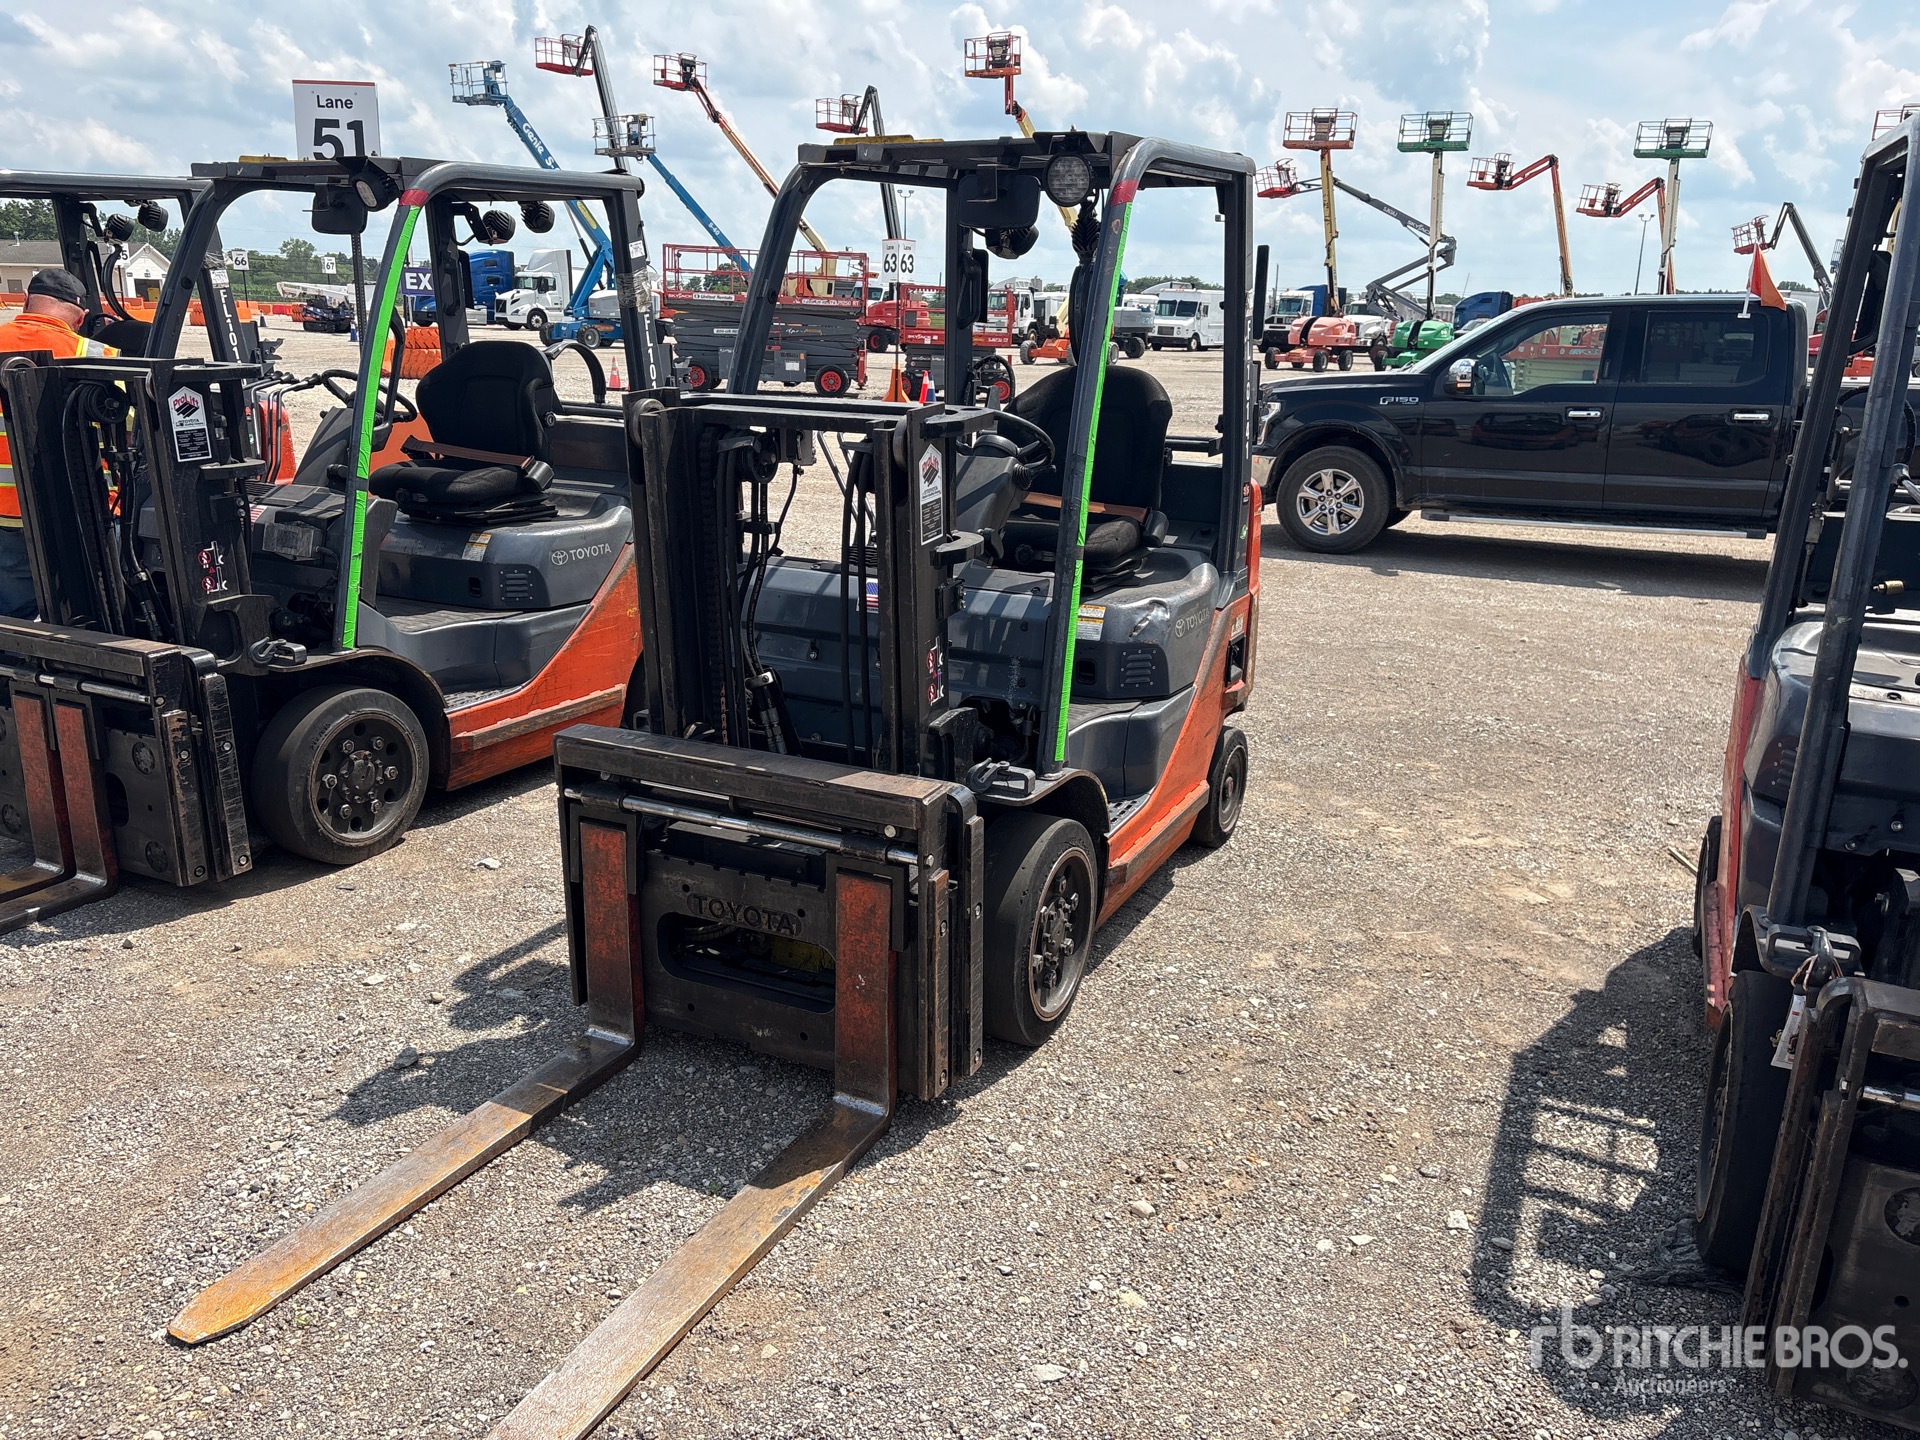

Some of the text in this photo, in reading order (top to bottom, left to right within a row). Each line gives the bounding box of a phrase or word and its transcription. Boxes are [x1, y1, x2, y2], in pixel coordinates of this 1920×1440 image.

[316, 94, 353, 109] Lane
[313, 118, 365, 160] 51
[522, 122, 545, 155] Genie
[1407, 220, 1431, 234] SKYJAC
[234, 256, 248, 266] 66
[326, 261, 336, 271] 67
[883, 253, 898, 273] 63
[900, 253, 914, 274] 63
[219, 289, 242, 363] FL101
[172, 393, 199, 409] ProLift
[569, 543, 612, 561] TOYOTA
[1186, 607, 1211, 631] TOYOTA
[693, 894, 797, 936] TOYOTA
